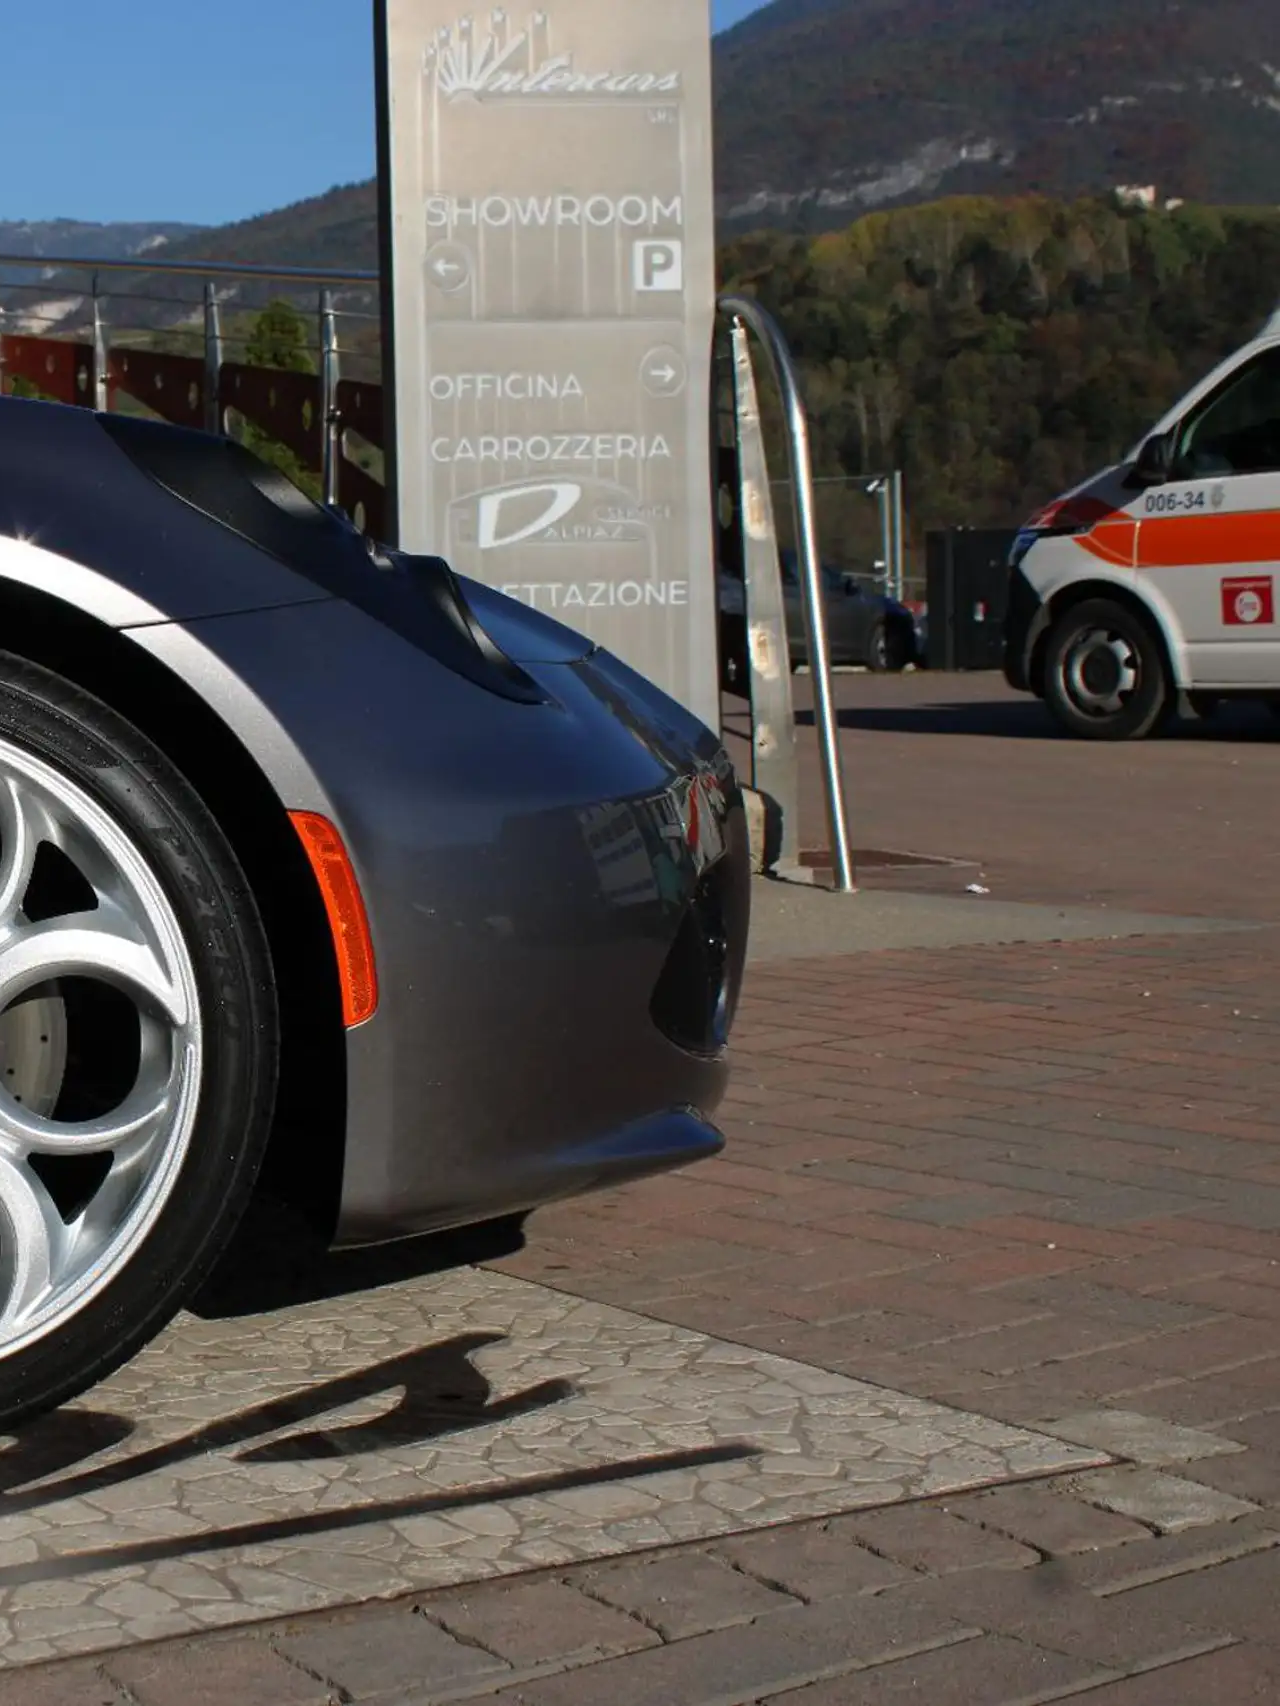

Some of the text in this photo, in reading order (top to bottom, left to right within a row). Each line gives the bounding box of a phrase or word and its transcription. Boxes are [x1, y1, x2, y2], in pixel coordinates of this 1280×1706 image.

[426, 194, 682, 227] SHOWROOM
[642, 244, 674, 288] P
[429, 373, 583, 400] OFFICINA
[430, 434, 671, 463] CARROZZERIA
[1145, 491, 1206, 513] 006-34
